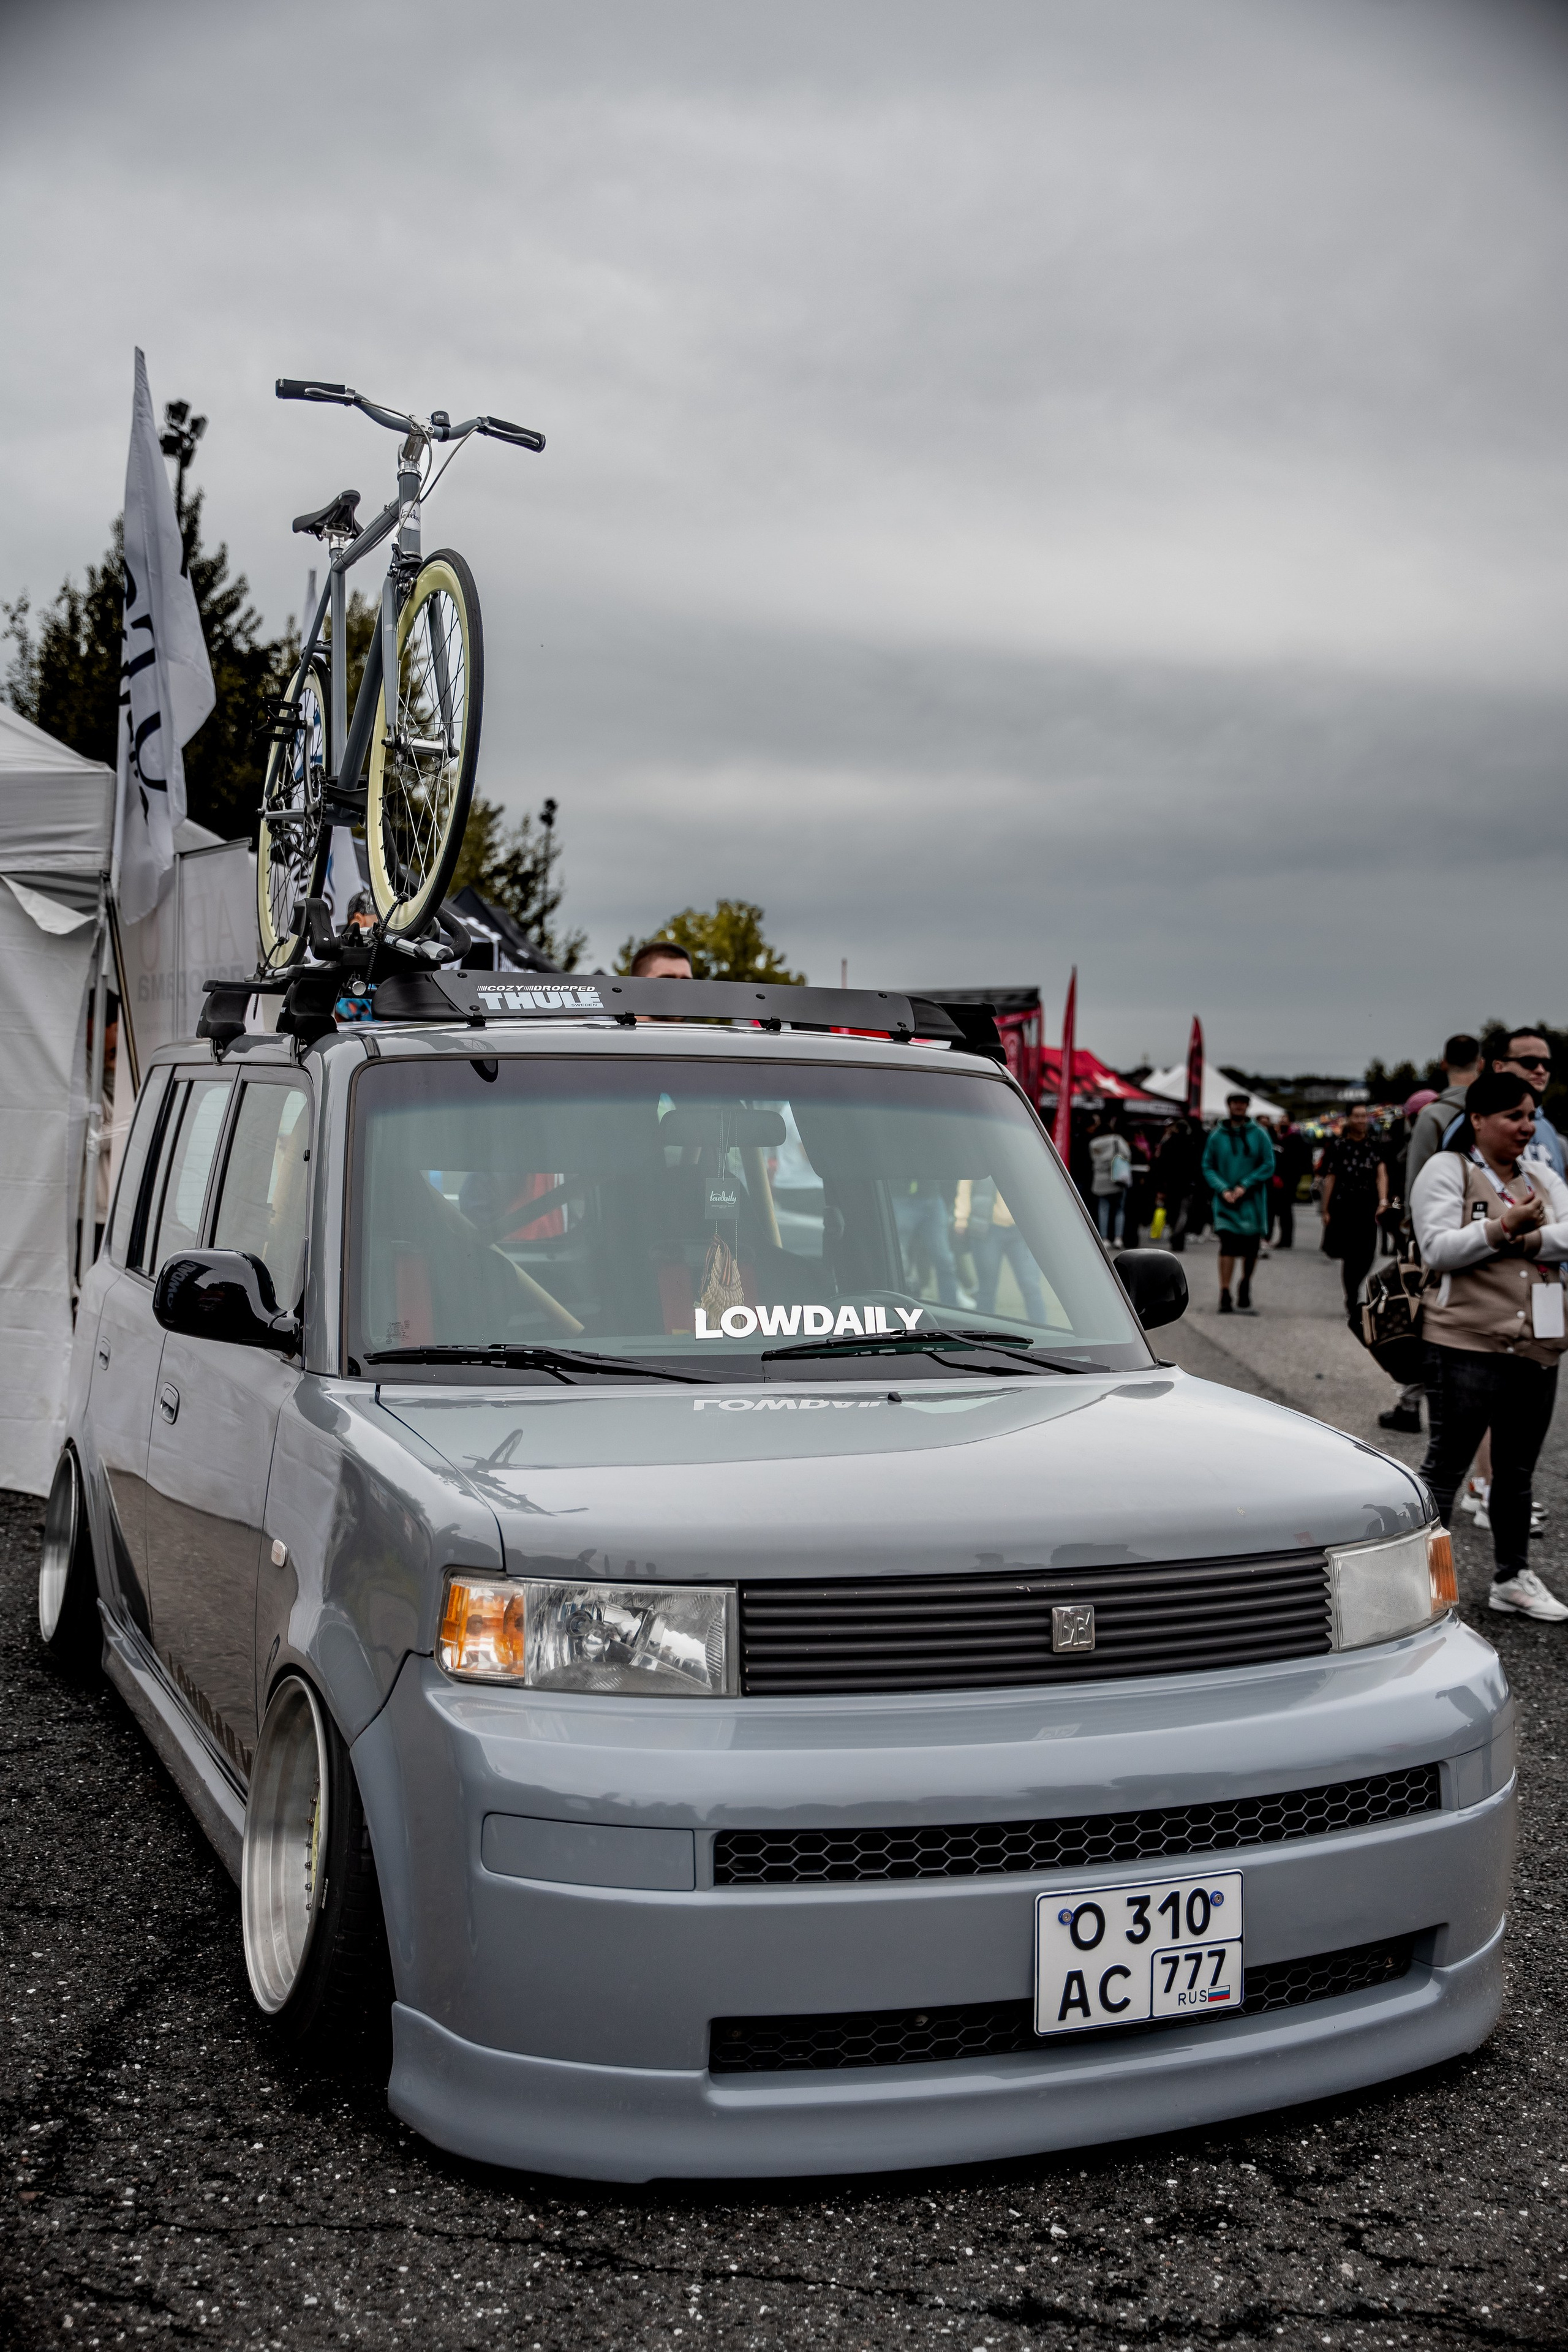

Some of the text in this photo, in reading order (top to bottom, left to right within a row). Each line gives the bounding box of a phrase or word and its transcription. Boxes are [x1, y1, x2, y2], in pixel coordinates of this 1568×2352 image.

[478, 992, 605, 1010] THULE
[695, 1305, 924, 1339] LOWDAILY
[1069, 1887, 1211, 1951] O 310
[1161, 1948, 1226, 1994] 777
[1057, 1964, 1132, 2021] AC
[1178, 1990, 1207, 2006] RUS
